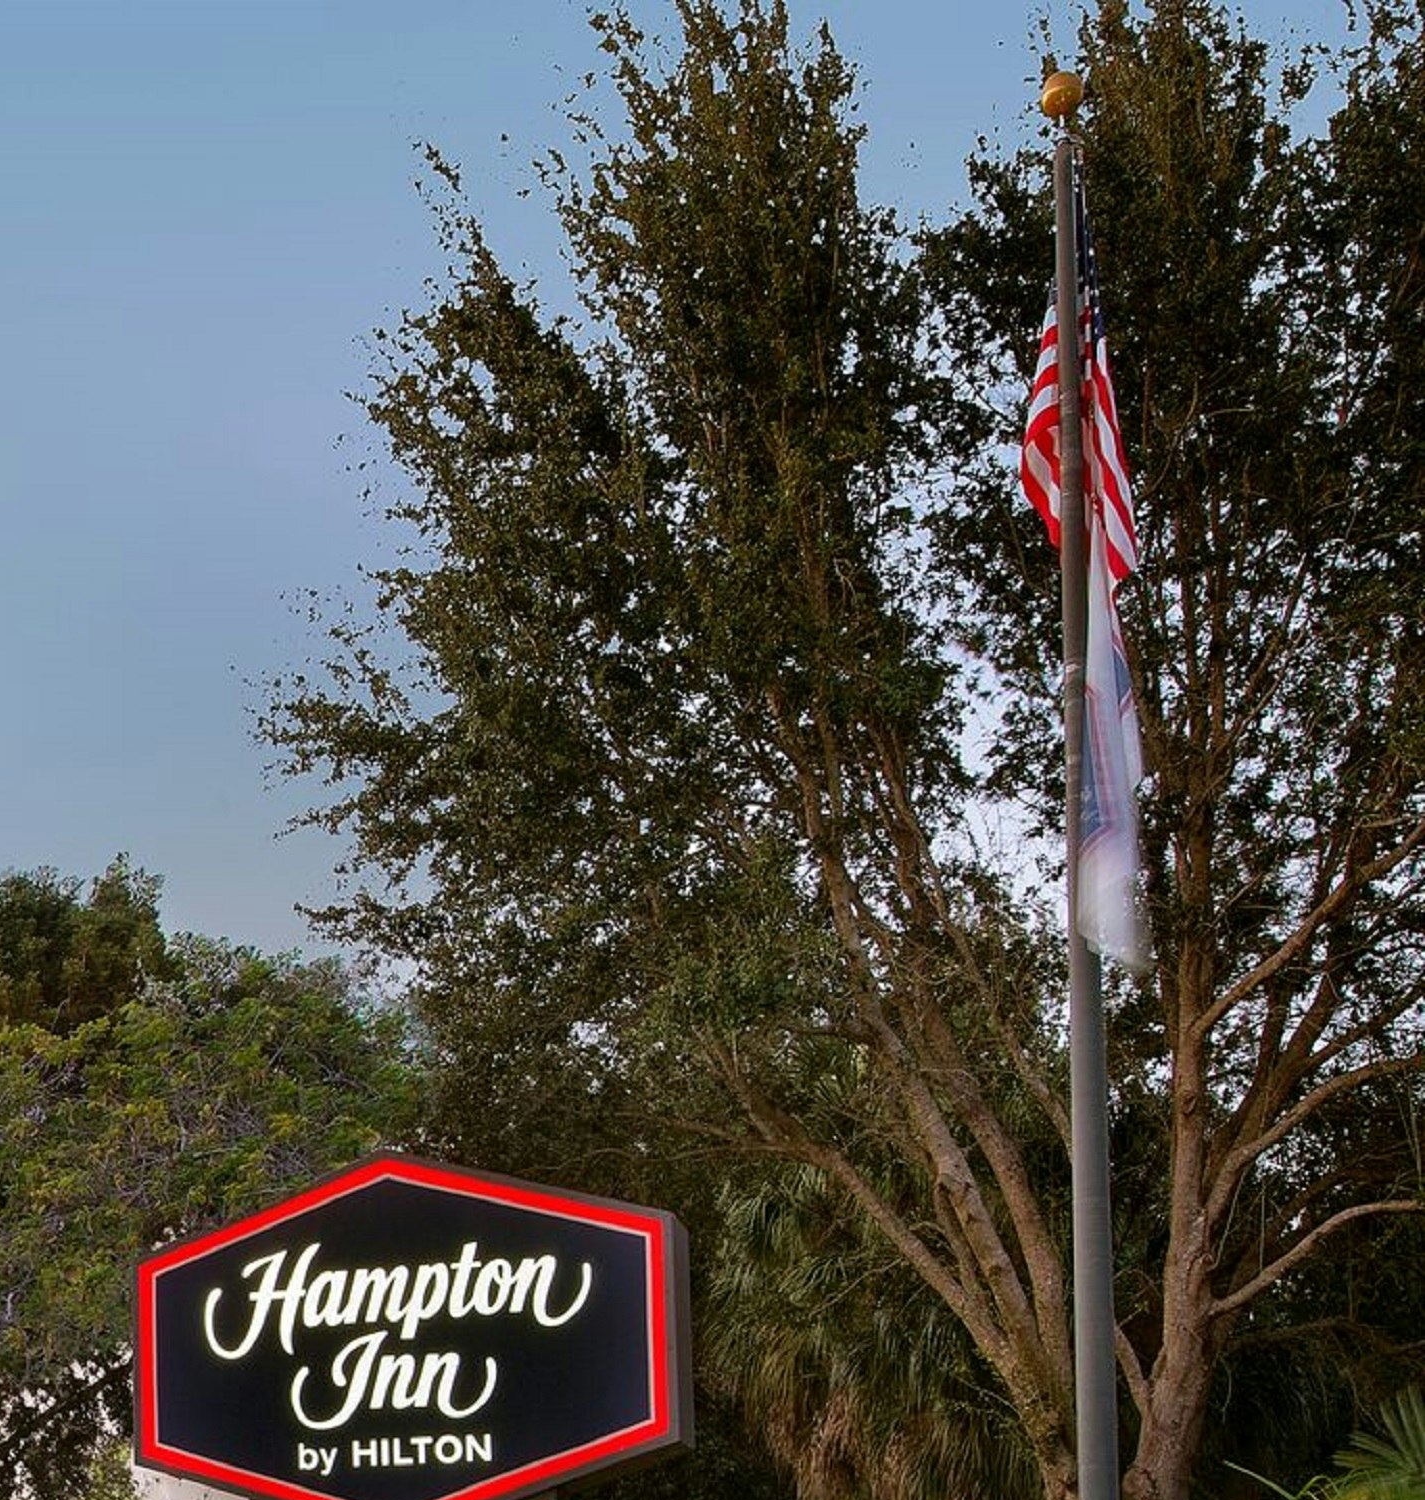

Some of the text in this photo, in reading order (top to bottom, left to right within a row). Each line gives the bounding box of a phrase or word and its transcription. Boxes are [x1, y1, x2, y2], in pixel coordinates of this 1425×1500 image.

[204, 1241, 592, 1359] Hampton
[291, 1330, 497, 1430] Inn
[298, 1434, 493, 1475] by HILTON
